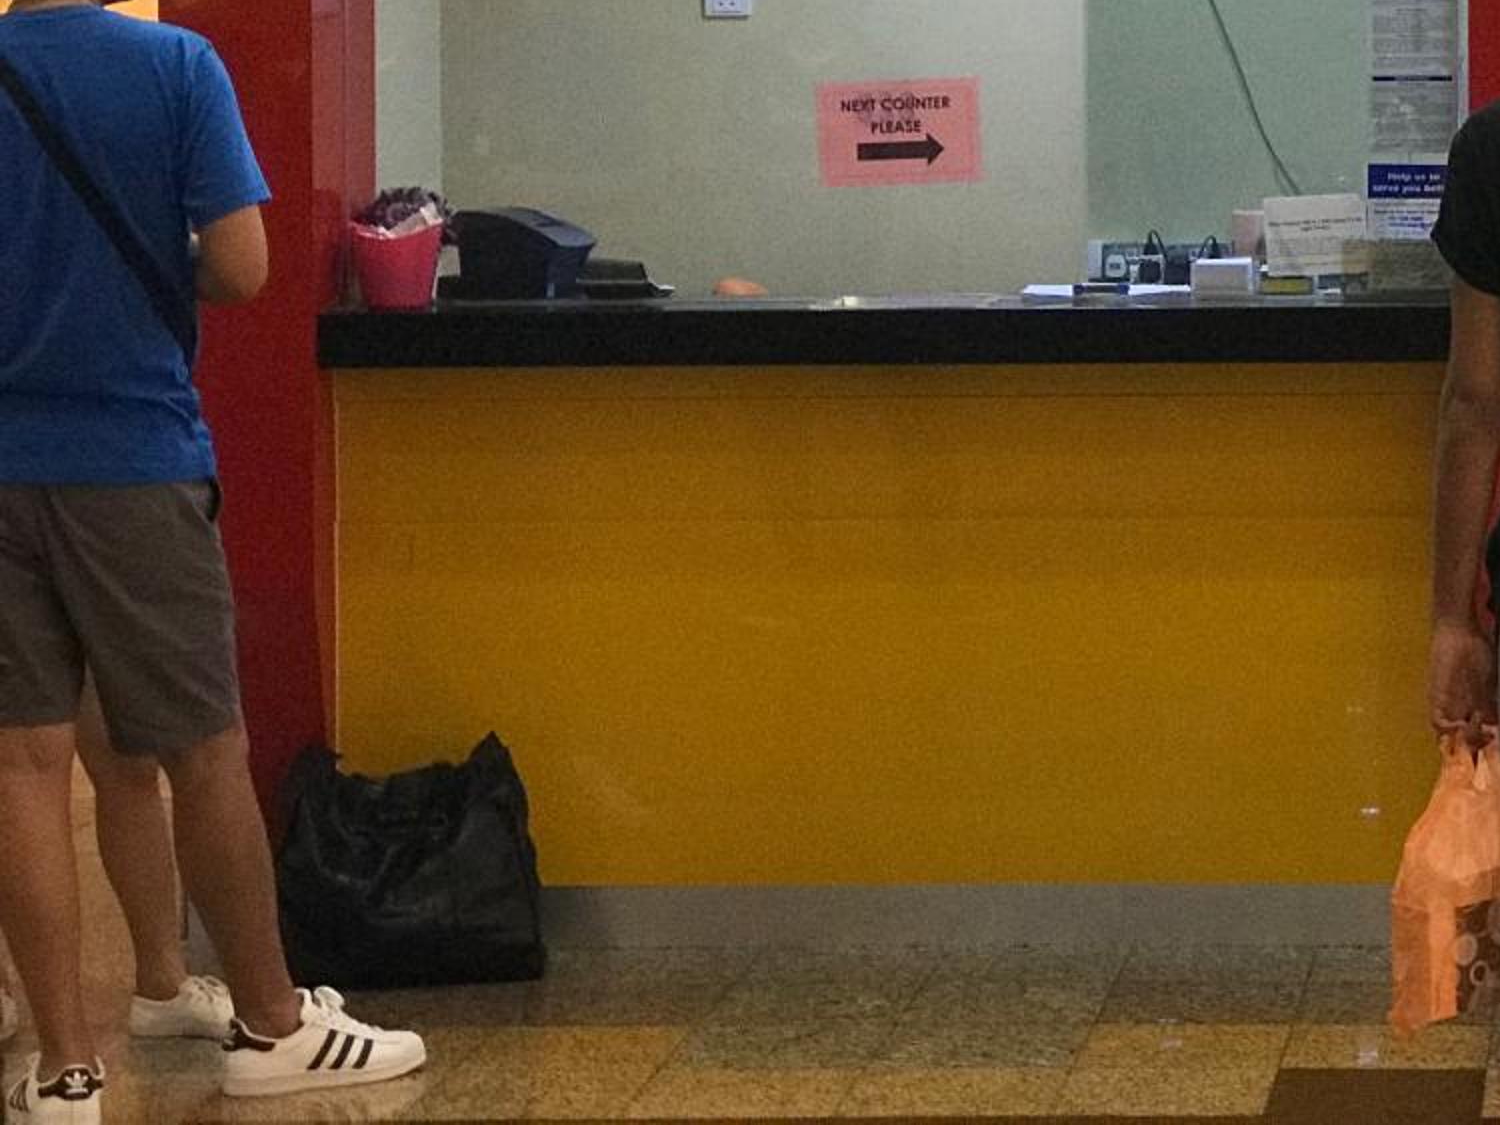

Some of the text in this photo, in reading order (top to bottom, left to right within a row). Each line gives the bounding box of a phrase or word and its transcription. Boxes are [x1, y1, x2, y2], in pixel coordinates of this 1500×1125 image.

[840, 96, 951, 112] NEXT COUNTER
[871, 120, 921, 134] PLEASE
